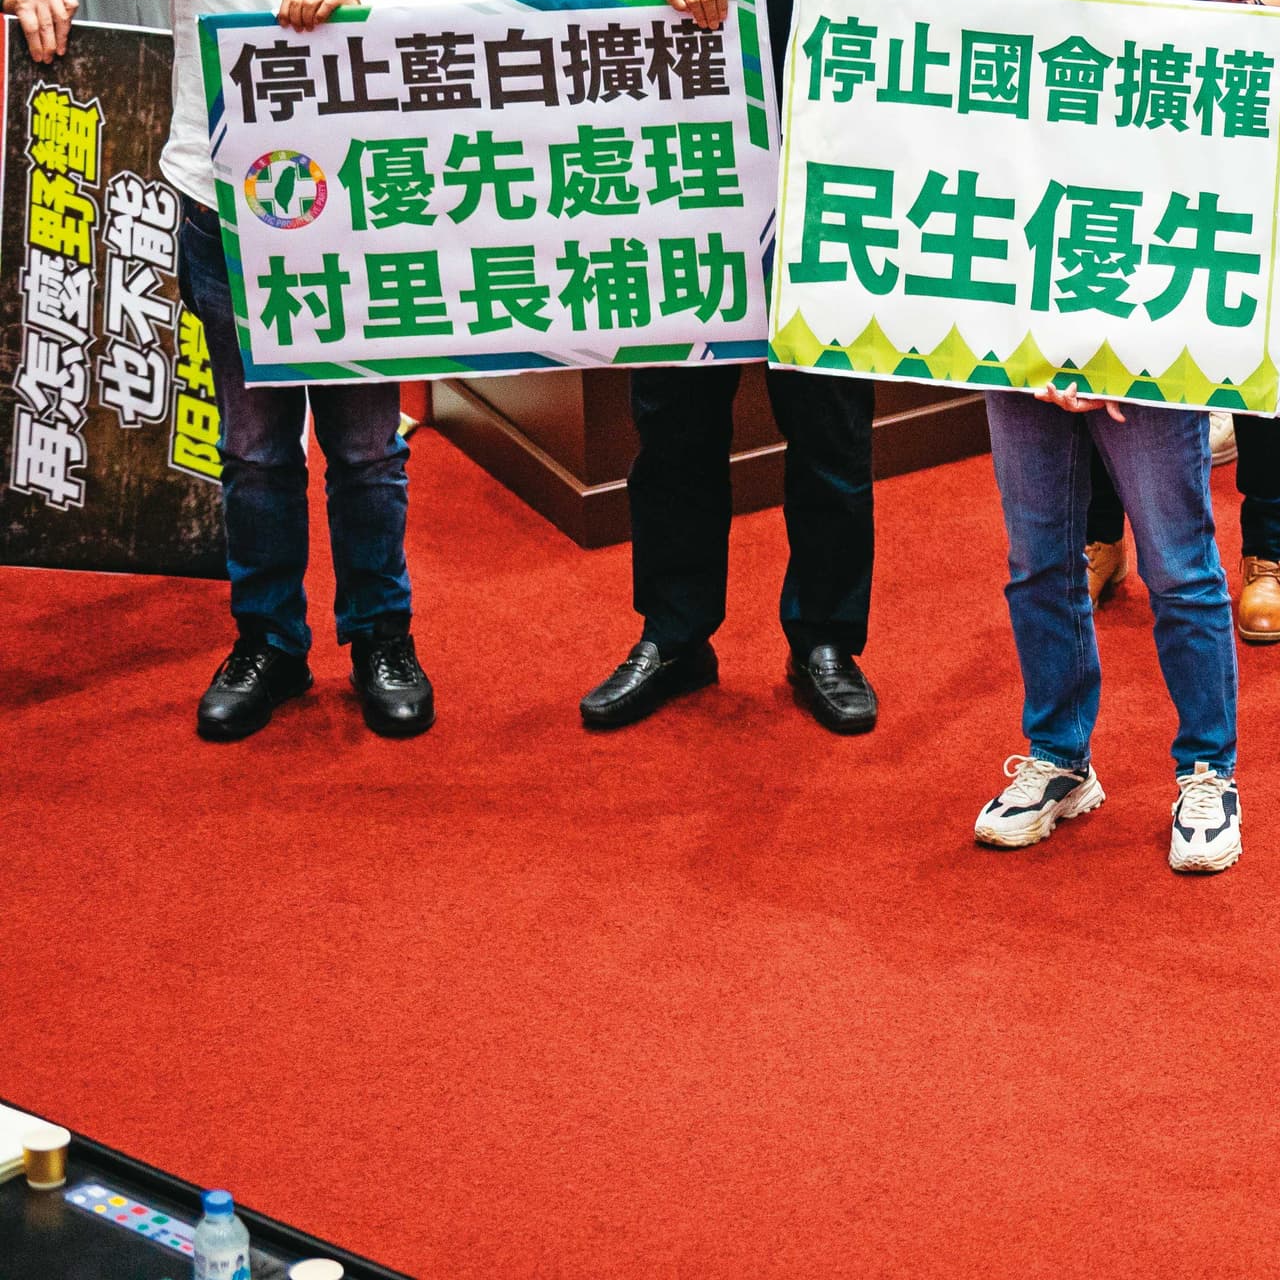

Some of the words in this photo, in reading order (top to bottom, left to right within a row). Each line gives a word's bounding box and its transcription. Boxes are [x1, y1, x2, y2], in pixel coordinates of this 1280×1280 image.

[229, 18, 731, 124] 停止藍白擴權
[802, 14, 1275, 139] 停止國會擴權
[337, 120, 745, 232] 優先處理
[16, 90, 100, 504] 再怎麼野蠻
[101, 174, 178, 426] 也不能
[256, 232, 748, 347] 村里長補助
[787, 160, 1262, 329] 民生優先
